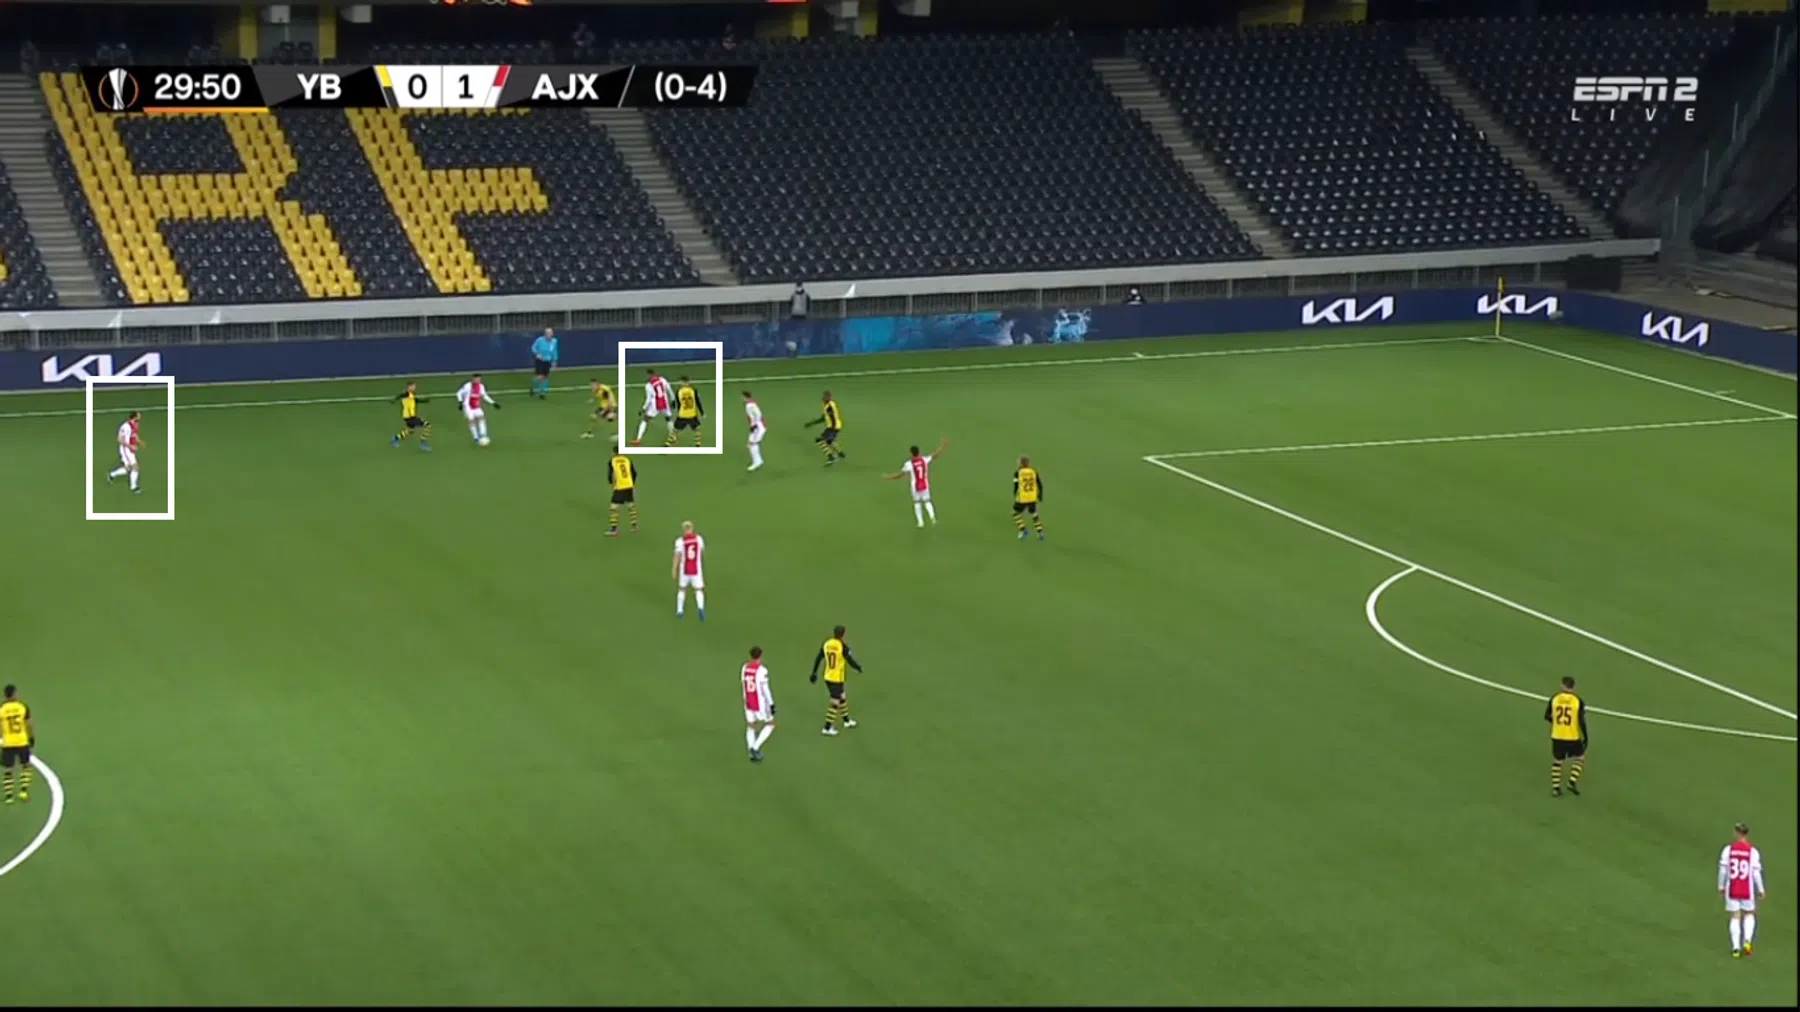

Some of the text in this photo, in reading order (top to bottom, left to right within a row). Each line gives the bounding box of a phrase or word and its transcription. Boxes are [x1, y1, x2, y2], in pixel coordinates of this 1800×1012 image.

[1302, 296, 1394, 325] KIA
[1642, 310, 1709, 347] KIA
[687, 545, 696, 560] 6
[1556, 705, 1572, 726] 25
[1729, 857, 1749, 880] 39
